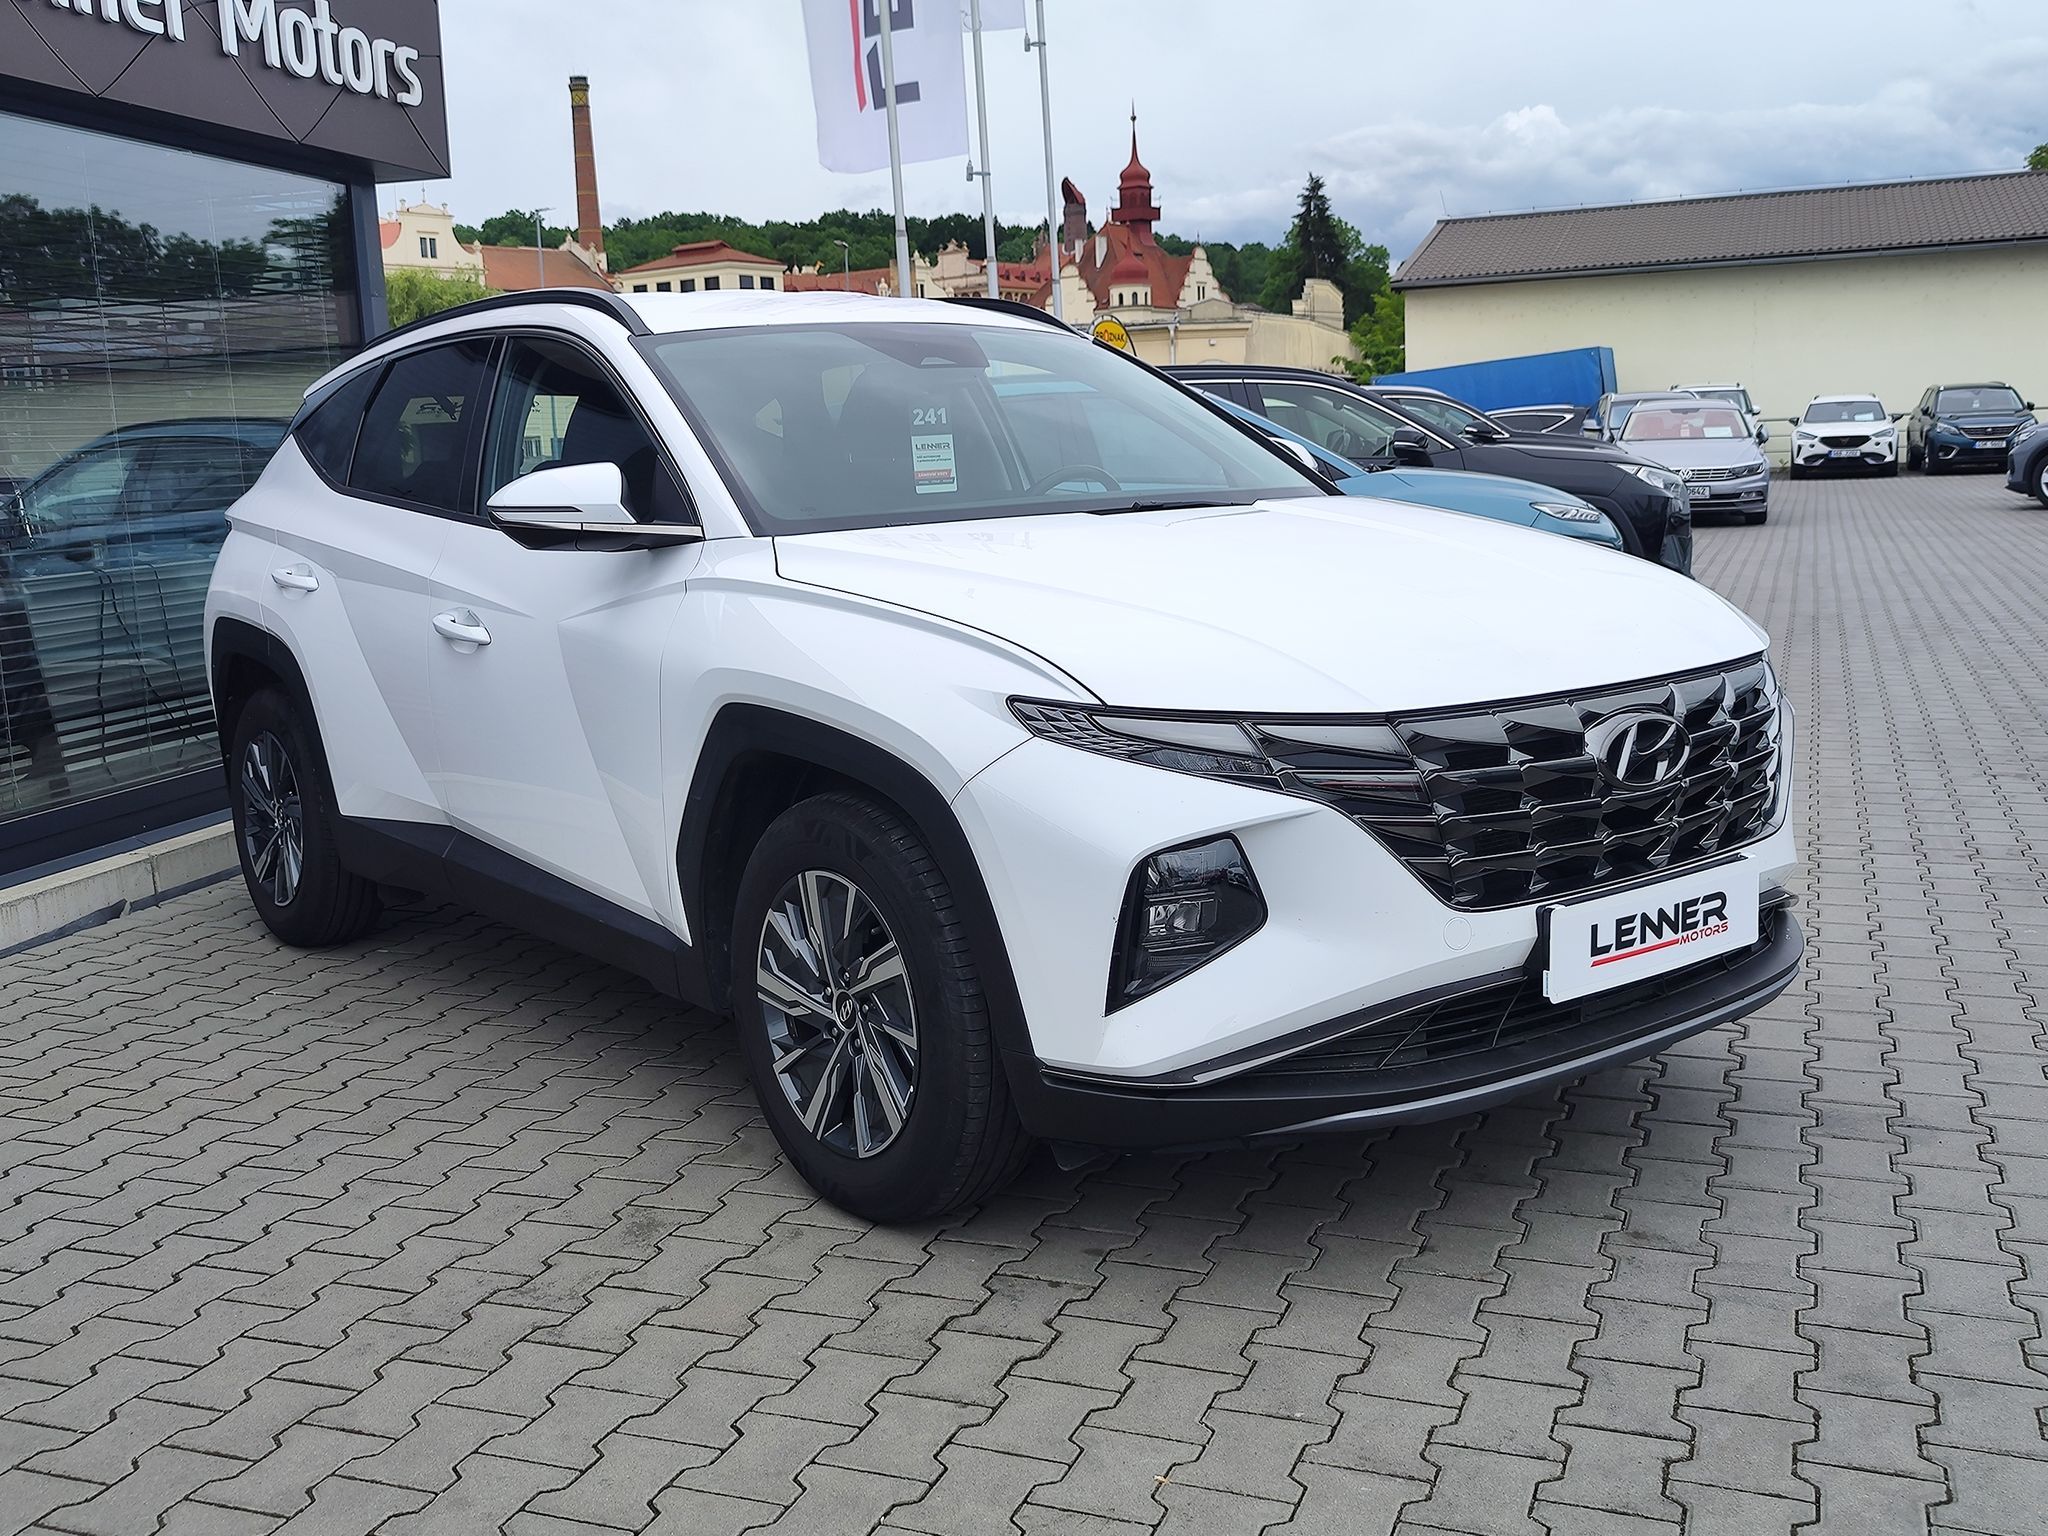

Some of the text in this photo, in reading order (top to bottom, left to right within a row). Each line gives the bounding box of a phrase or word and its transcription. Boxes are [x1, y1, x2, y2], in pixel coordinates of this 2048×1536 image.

[218, 0, 424, 107] Motors
[912, 407, 947, 426] 241
[1590, 891, 1729, 958] LENNER
[1679, 921, 1729, 946] MOTORS
